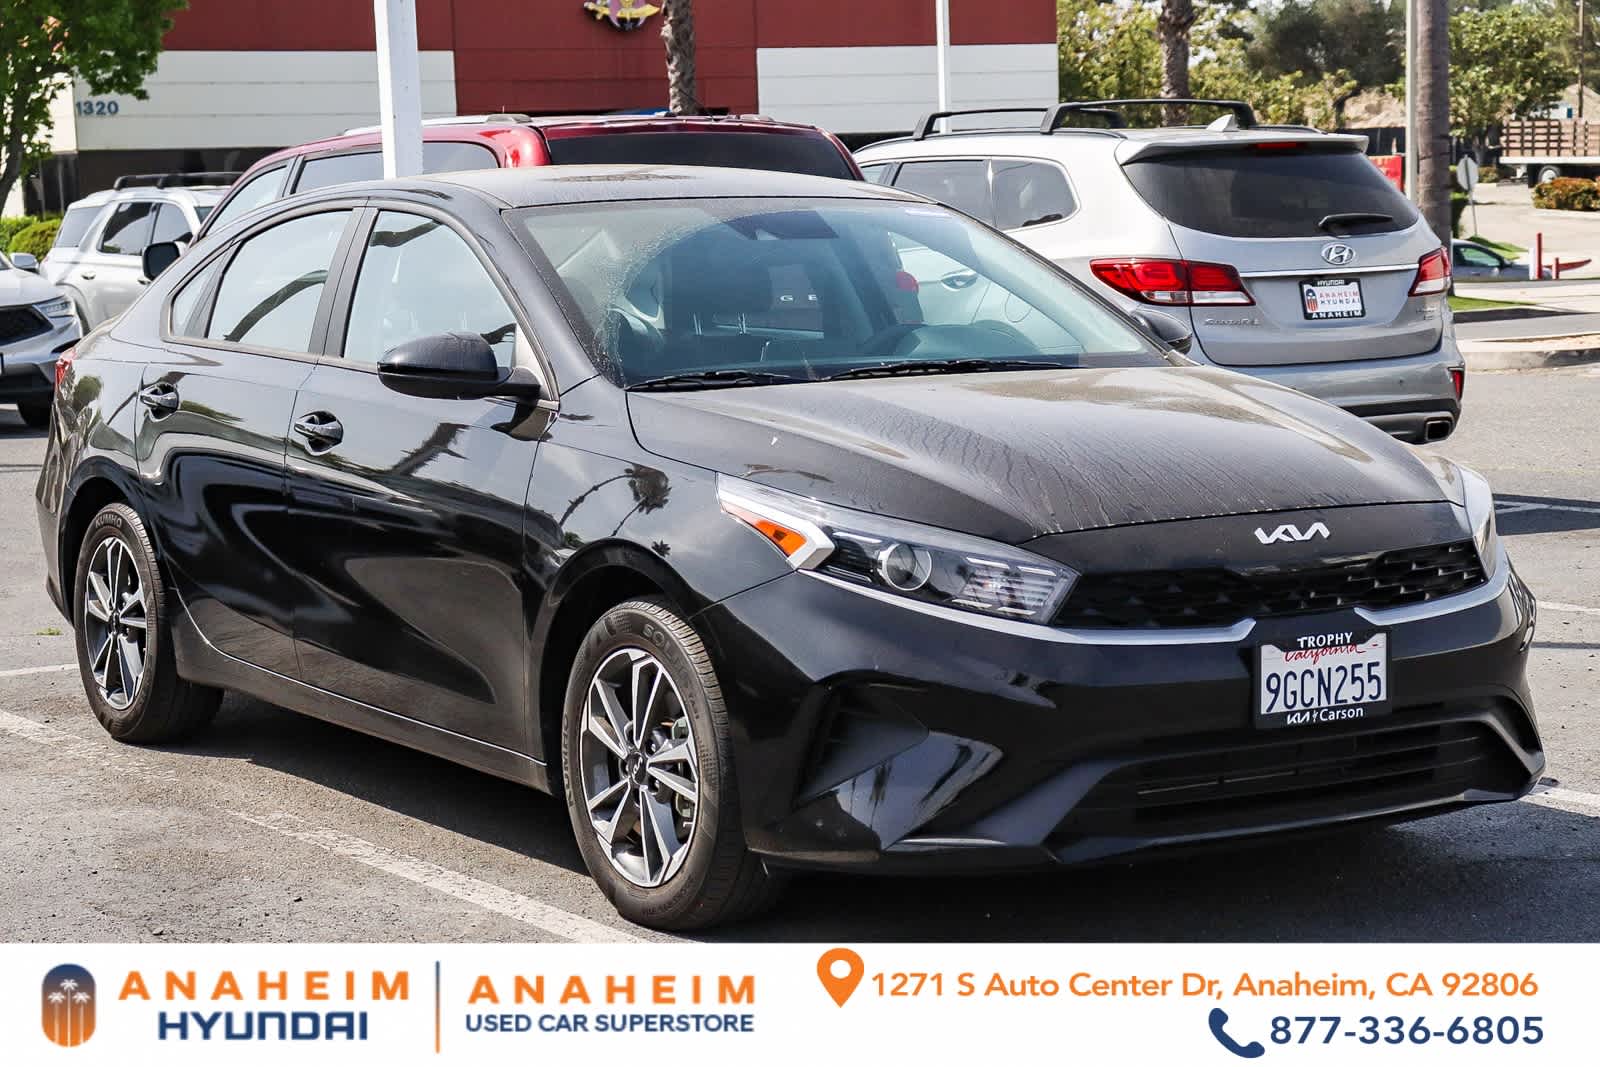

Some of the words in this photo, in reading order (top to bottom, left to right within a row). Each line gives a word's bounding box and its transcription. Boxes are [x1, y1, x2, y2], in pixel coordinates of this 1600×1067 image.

[76, 100, 119, 116] 1320
[1319, 290, 1360, 299] ANAHEIM
[1312, 309, 1363, 319] ANAHEIM
[95, 513, 123, 529] KUMHO
[1297, 631, 1353, 649] TROPHY
[1265, 661, 1382, 713] 9GCN255
[1320, 707, 1364, 722] Carson
